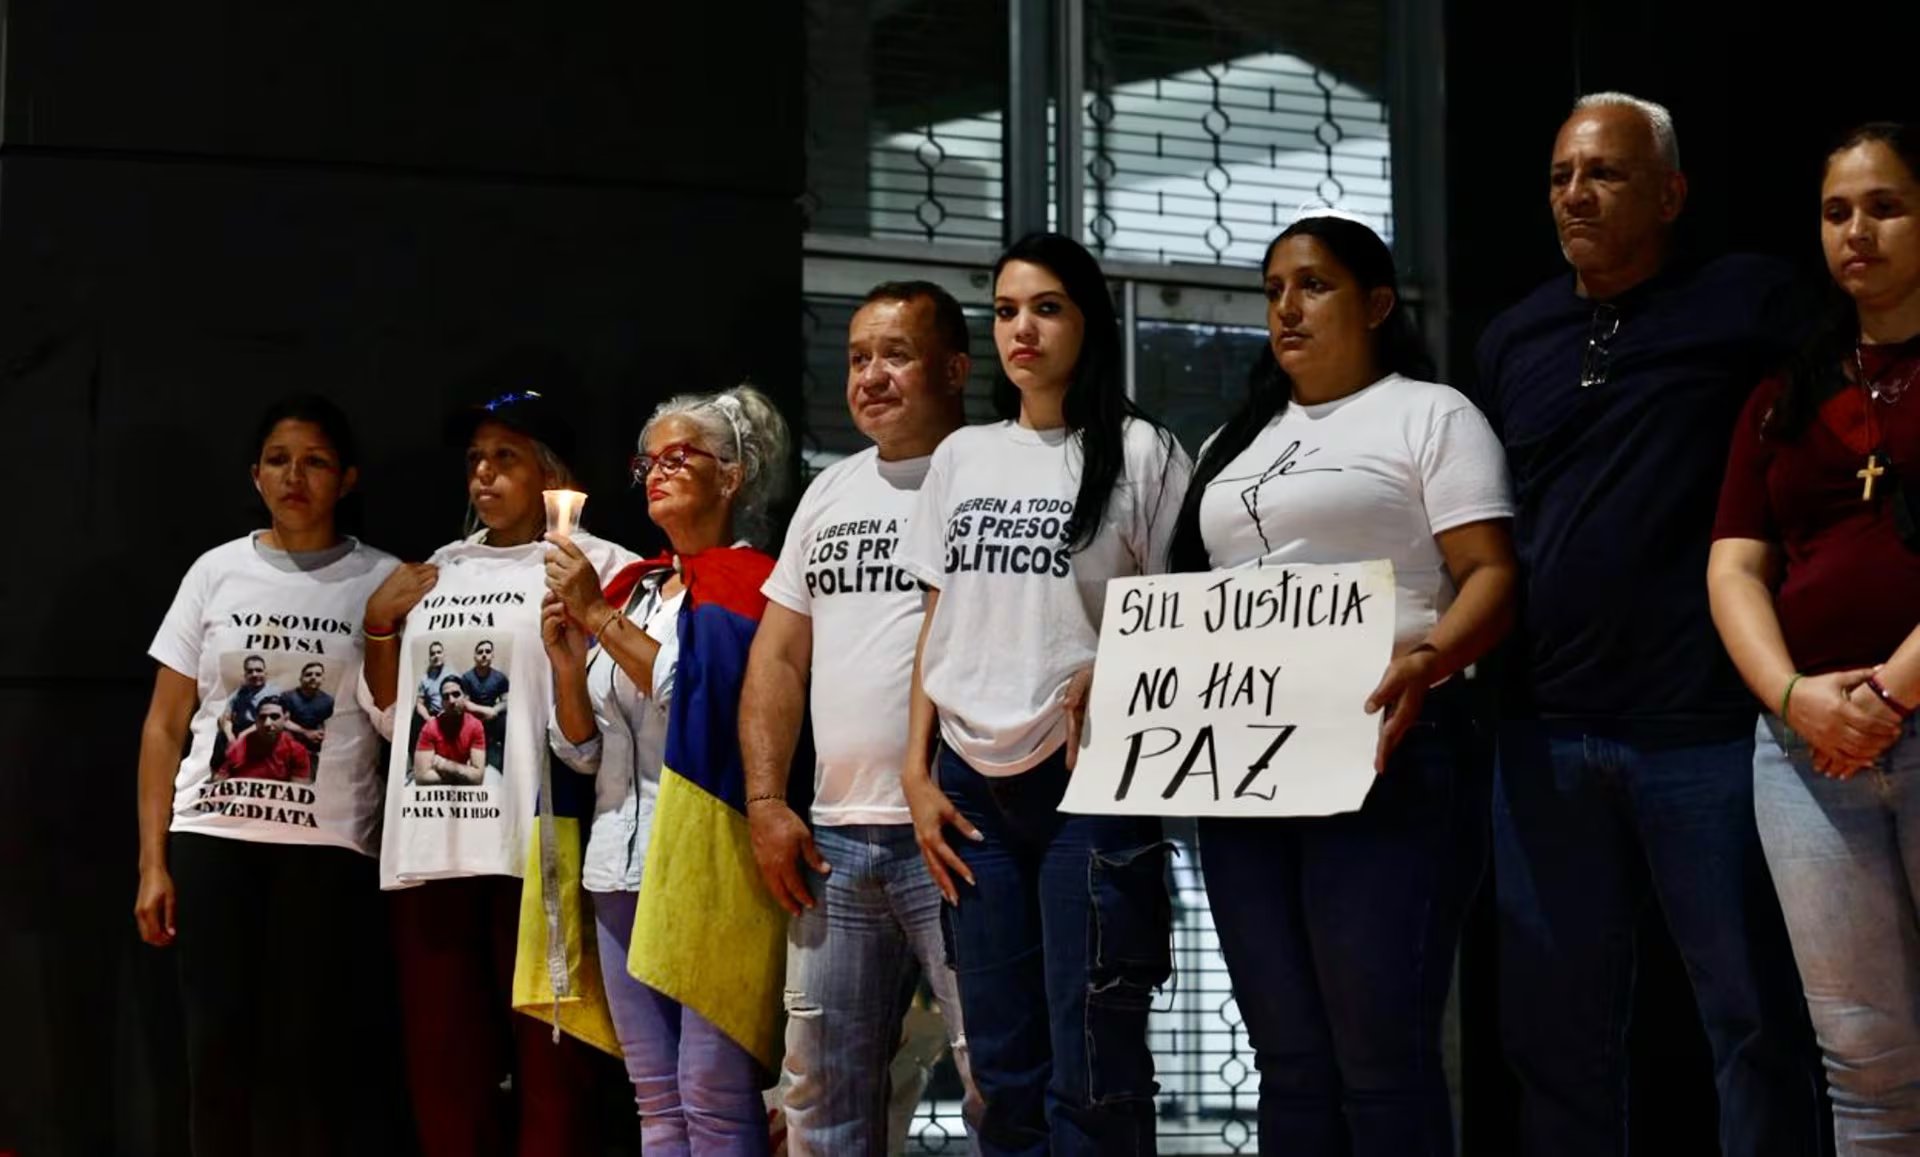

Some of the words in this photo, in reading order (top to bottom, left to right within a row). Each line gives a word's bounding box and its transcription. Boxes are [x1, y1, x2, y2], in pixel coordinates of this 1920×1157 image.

[1010, 500, 1022, 514] A
[1027, 498, 1073, 514] TODO
[816, 519, 881, 542] LIBEREN
[885, 519, 897, 533] A
[946, 515, 972, 543] OS
[977, 515, 1073, 543] PRESOS
[809, 540, 849, 565] LOS
[944, 537, 1071, 578] OLÍTICOS
[417, 595, 446, 612] NO
[448, 591, 527, 607] SOMOS
[229, 613, 263, 628] NO
[266, 614, 353, 635] SOMOS
[427, 612, 495, 630] PDVSA
[245, 634, 326, 655] PDVSA
[1128, 666, 1178, 716] NO
[1197, 661, 1281, 716] HAY
[1114, 724, 1298, 802] PAZ
[415, 790, 489, 803] LIBERTAD
[402, 806, 444, 818] PARA
[449, 807, 468, 819] MI
